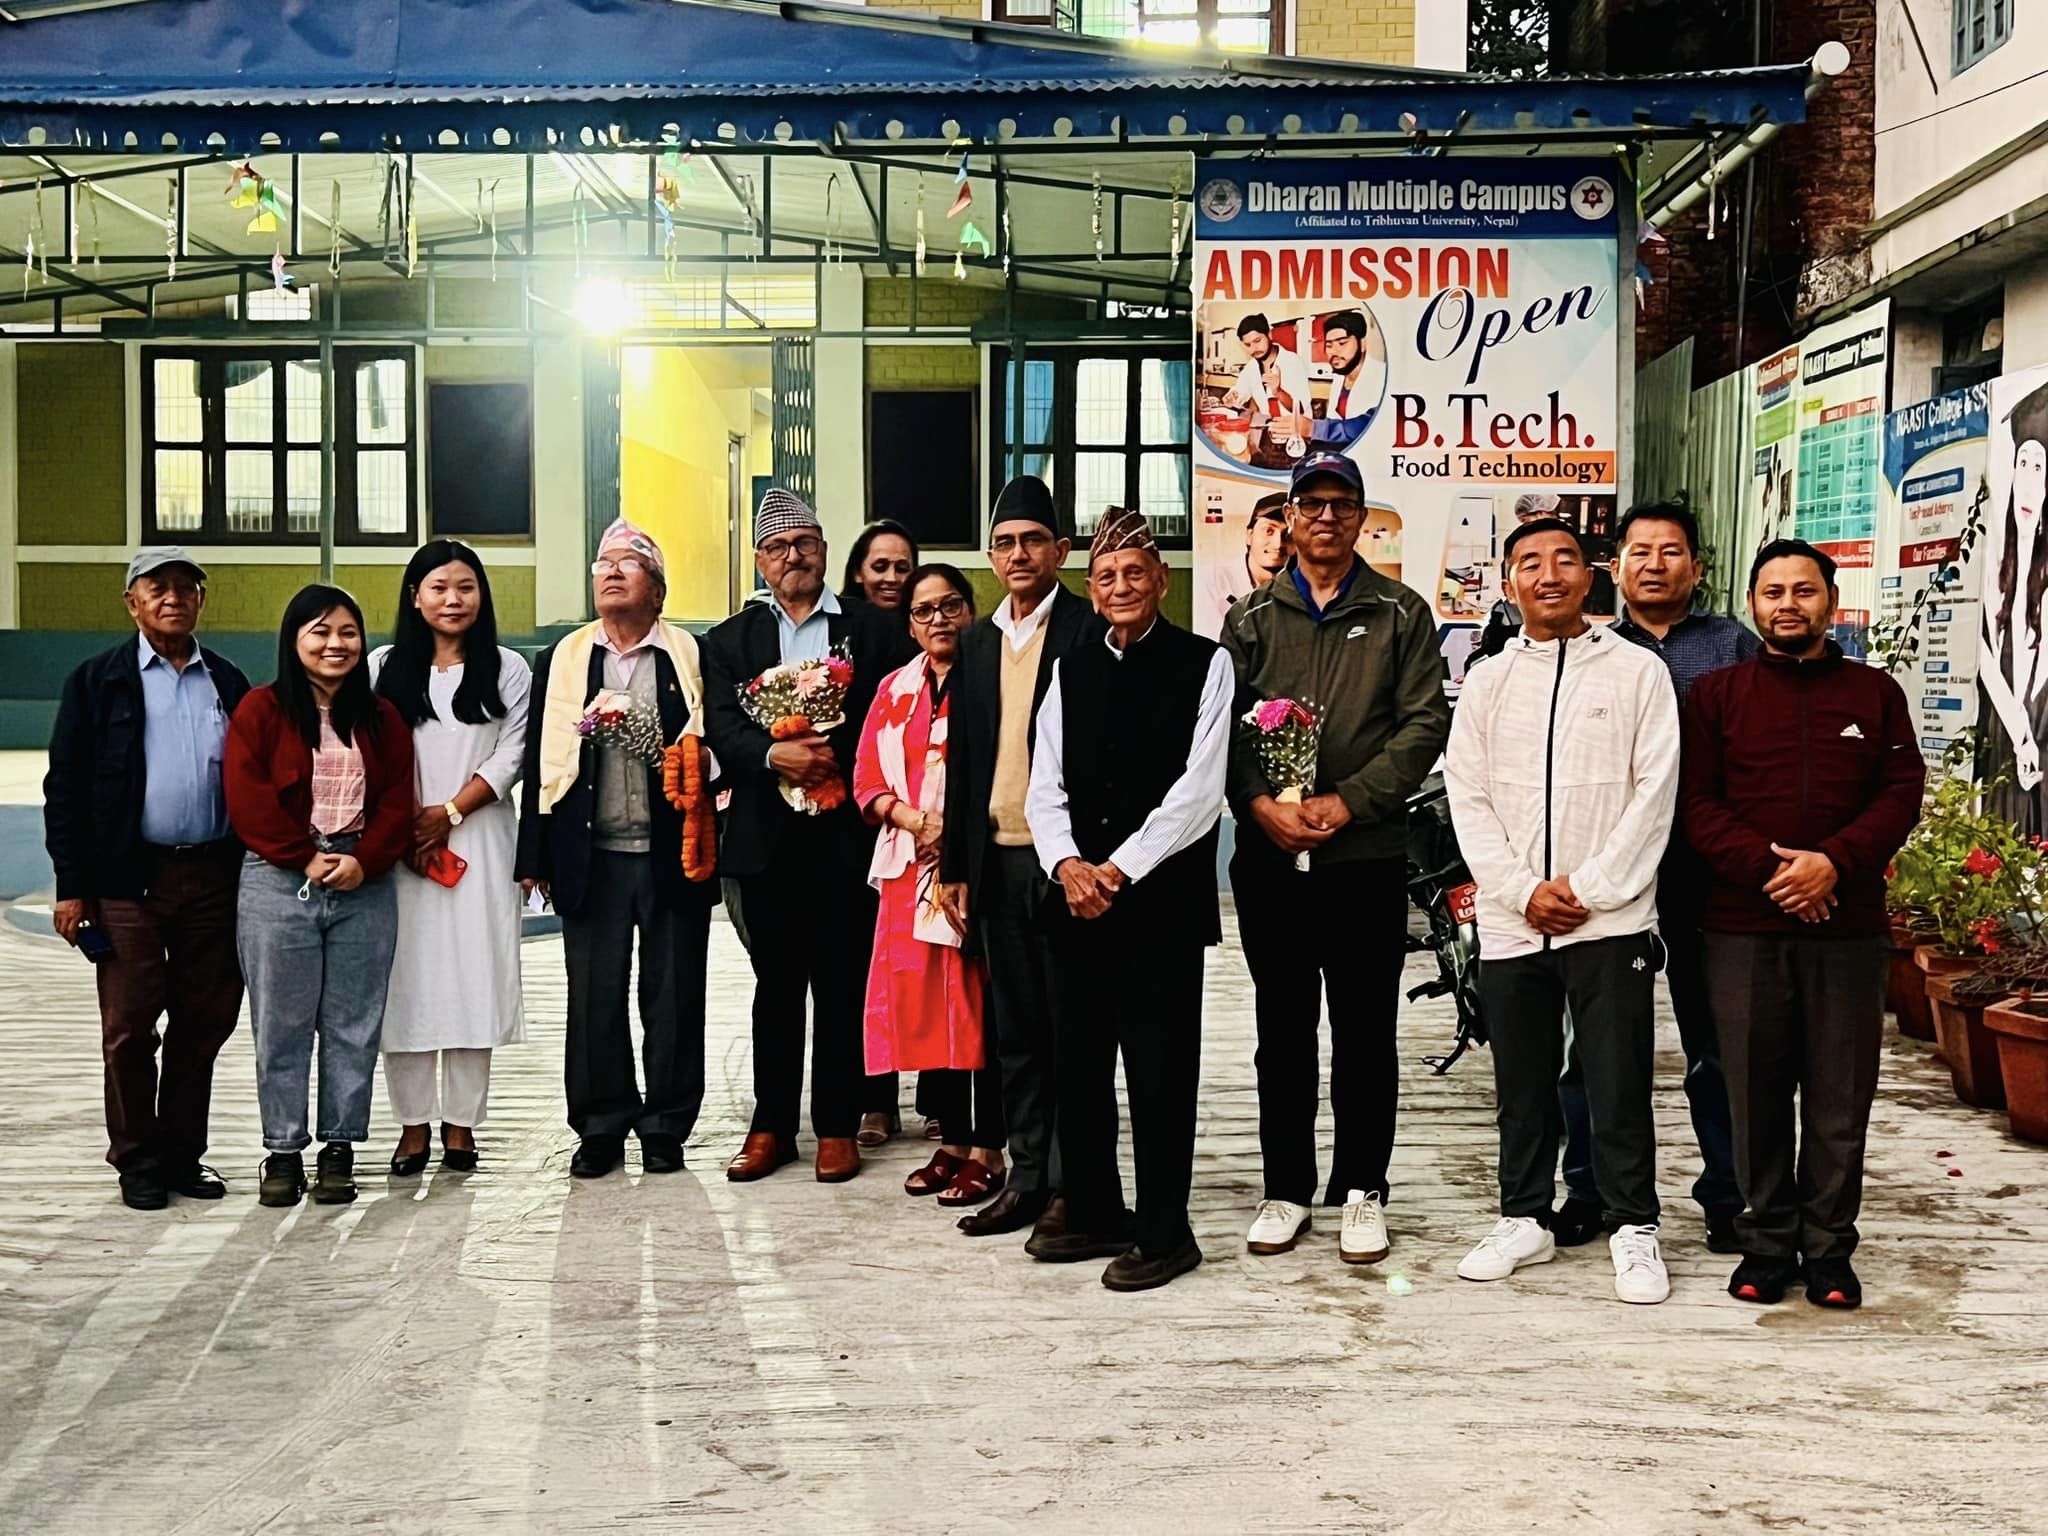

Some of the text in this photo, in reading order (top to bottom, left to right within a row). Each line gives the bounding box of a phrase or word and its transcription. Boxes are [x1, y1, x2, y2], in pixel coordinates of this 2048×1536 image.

[1248, 181, 1341, 212] Dharan
[1347, 180, 1454, 213] Multiple
[1460, 179, 1567, 214] Campus
[1295, 214, 1519, 228] (Affiliated to Tribhuvan University, Nepal)
[1202, 247, 1509, 300] ADMISSION
[1416, 286, 1608, 387] Open
[1392, 390, 1595, 449] B.Tech.
[1896, 403, 1927, 438] NAAST
[1928, 397, 1963, 427] College
[1391, 454, 1607, 483] Food Technology
